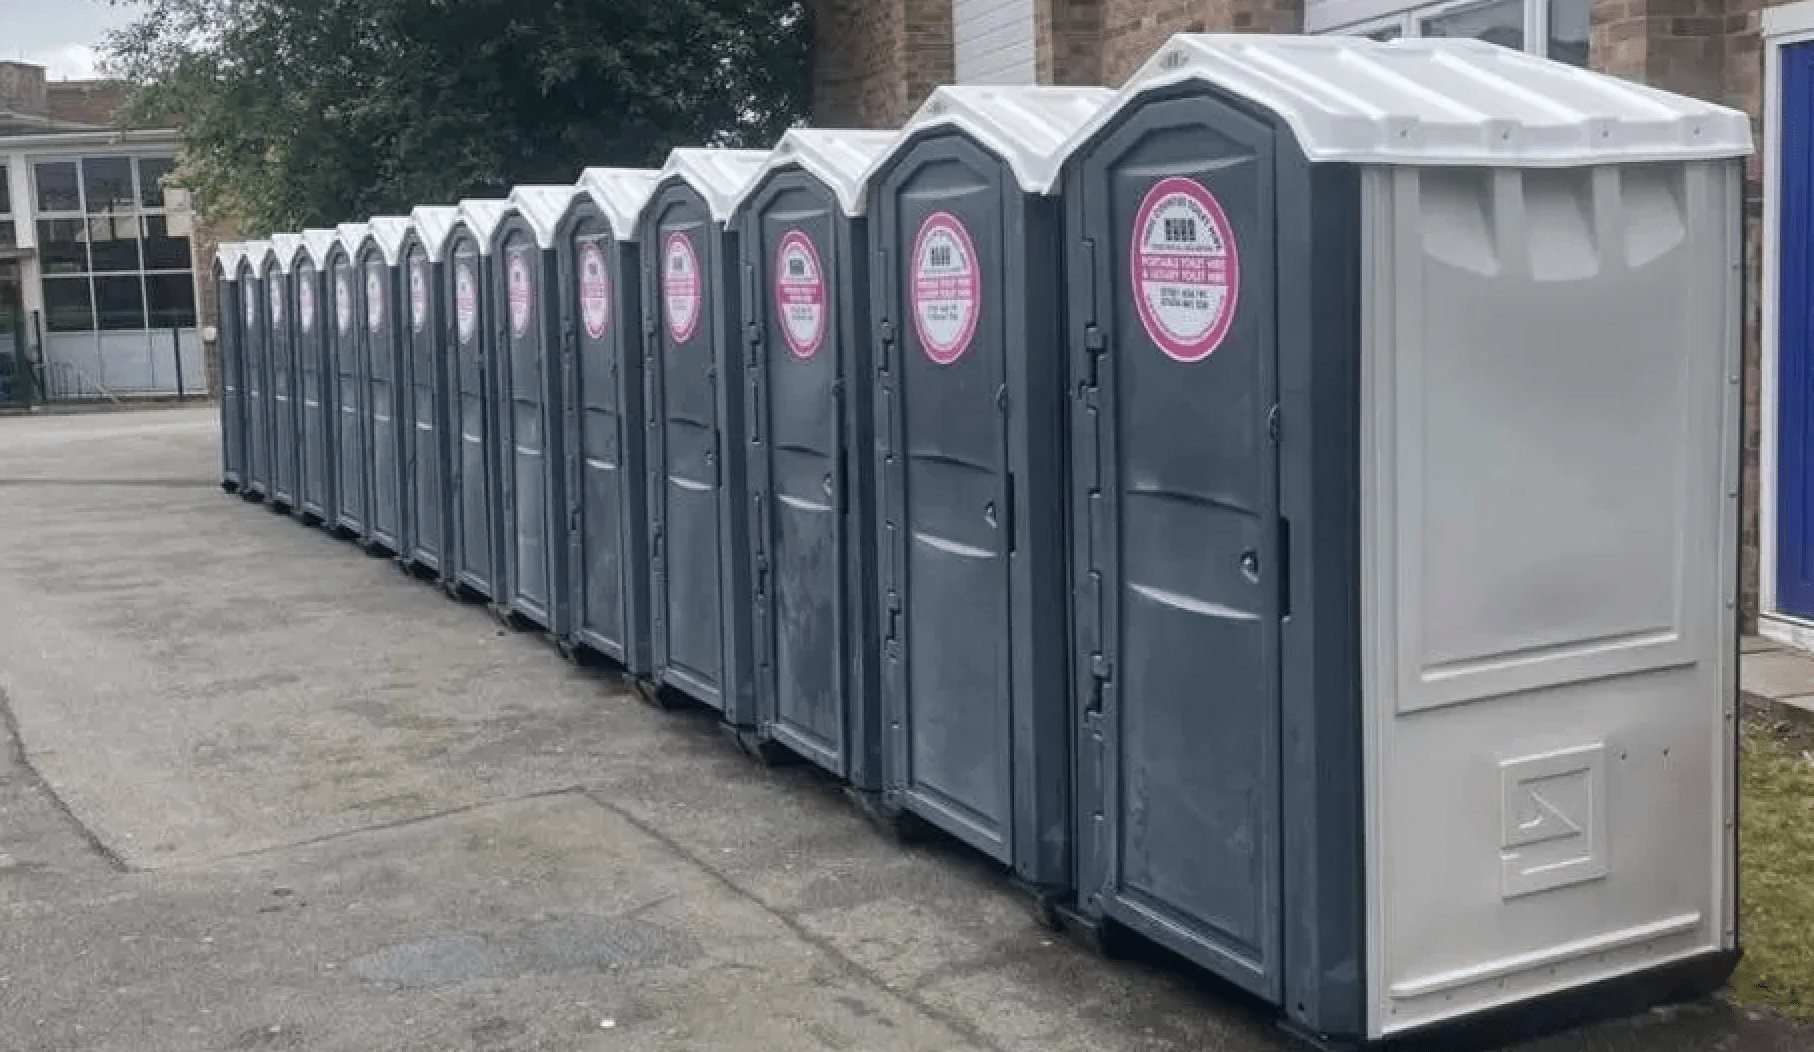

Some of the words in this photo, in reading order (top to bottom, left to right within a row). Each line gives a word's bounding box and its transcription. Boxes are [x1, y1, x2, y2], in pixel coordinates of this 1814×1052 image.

[1141, 257, 1178, 267] PORTABLE
[1181, 257, 1205, 269] TOILET
[1181, 269, 1205, 281] TOILET
